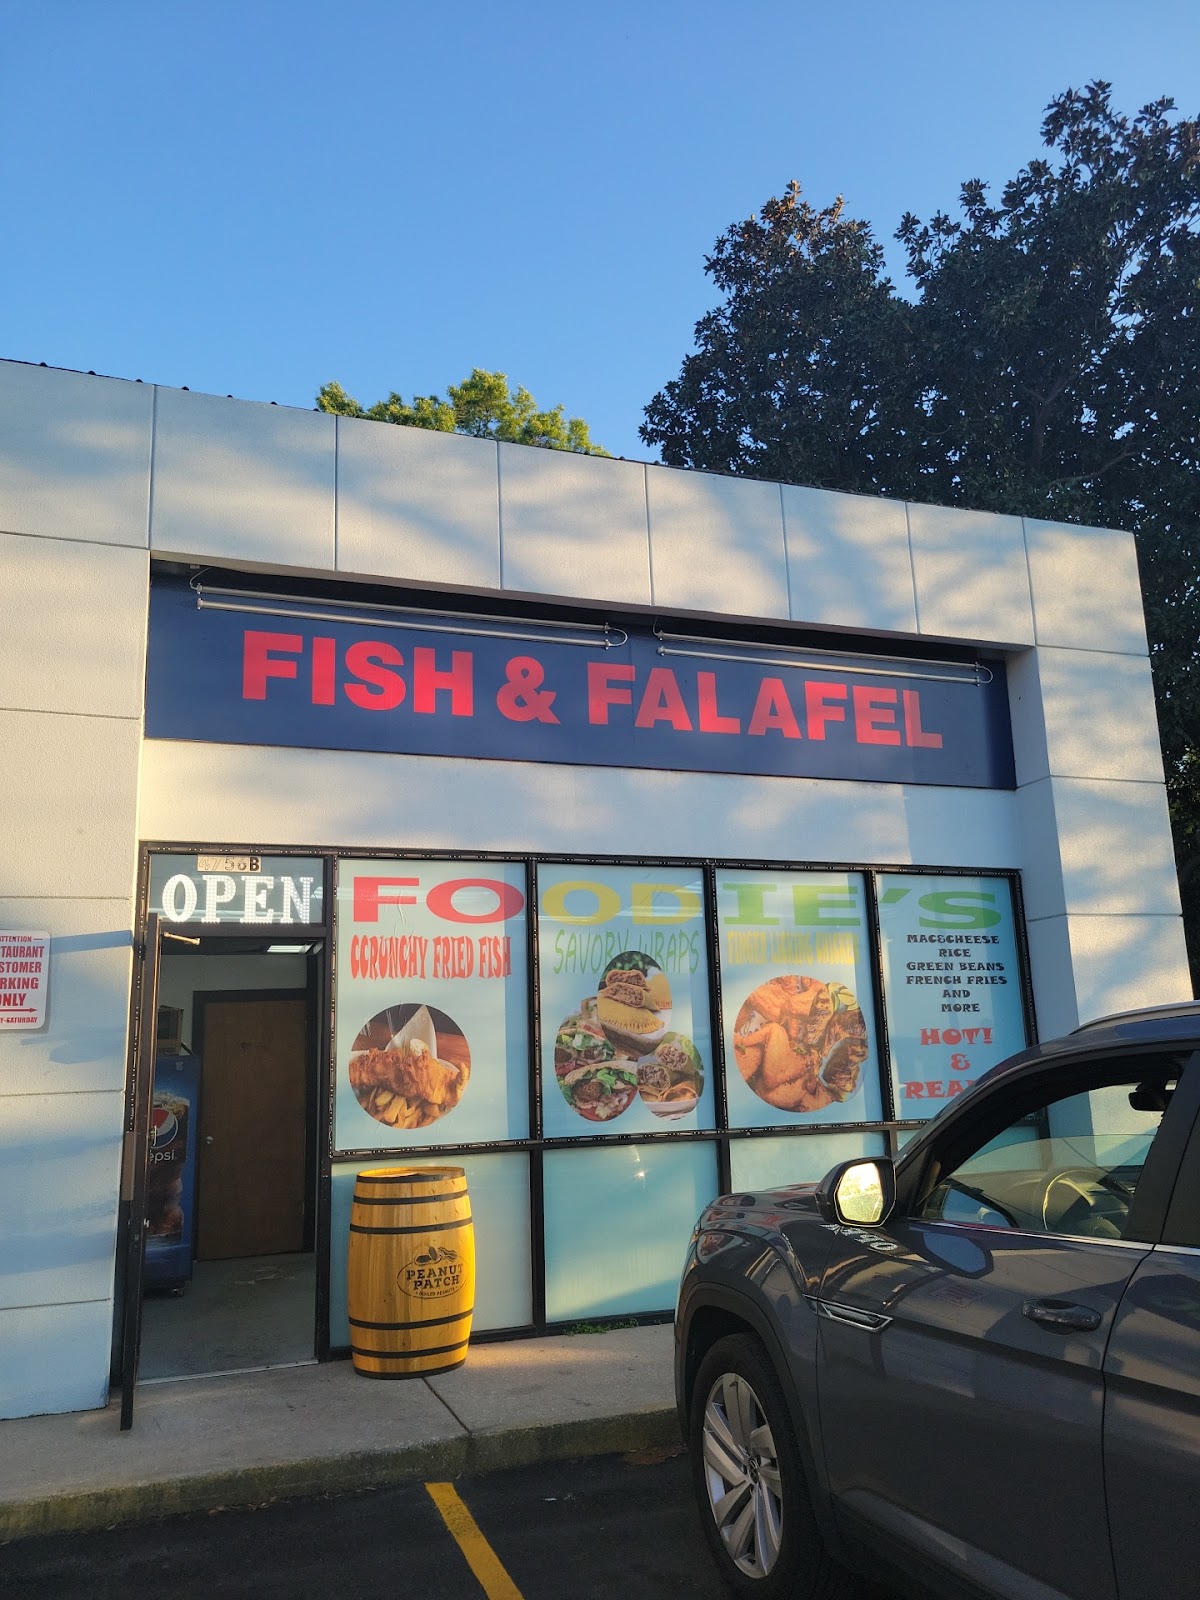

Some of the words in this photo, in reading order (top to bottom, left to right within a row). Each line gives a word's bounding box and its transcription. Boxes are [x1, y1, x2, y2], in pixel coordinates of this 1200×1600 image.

[243, 630, 473, 716] FISH
[496, 656, 561, 724] &
[587, 662, 943, 749] FALAFEL
[162, 874, 313, 924] OPEN
[906, 934, 1000, 944] MAC&CHEESE
[0, 945, 44, 958] TAURANT
[351, 934, 429, 981] CCRUNCHY
[432, 935, 475, 981] FRIED
[478, 935, 512, 979] FISH
[938, 948, 971, 958] RICE
[0, 961, 41, 973] STOMER
[906, 962, 954, 971] GREEN
[958, 962, 1005, 971] BEANS
[0, 977, 39, 990] RKING
[906, 975, 962, 985] FRENCH
[966, 975, 1008, 985] FRIES
[942, 989, 971, 998] AND
[941, 1003, 980, 1012] MORE
[920, 1027, 993, 1046] HOT!
[950, 1053, 971, 1071] &
[904, 1080, 977, 1099] REA
[150, 1150, 175, 1165] epsi
[407, 1264, 463, 1280] PEANUT
[414, 1275, 459, 1290] PATCH
